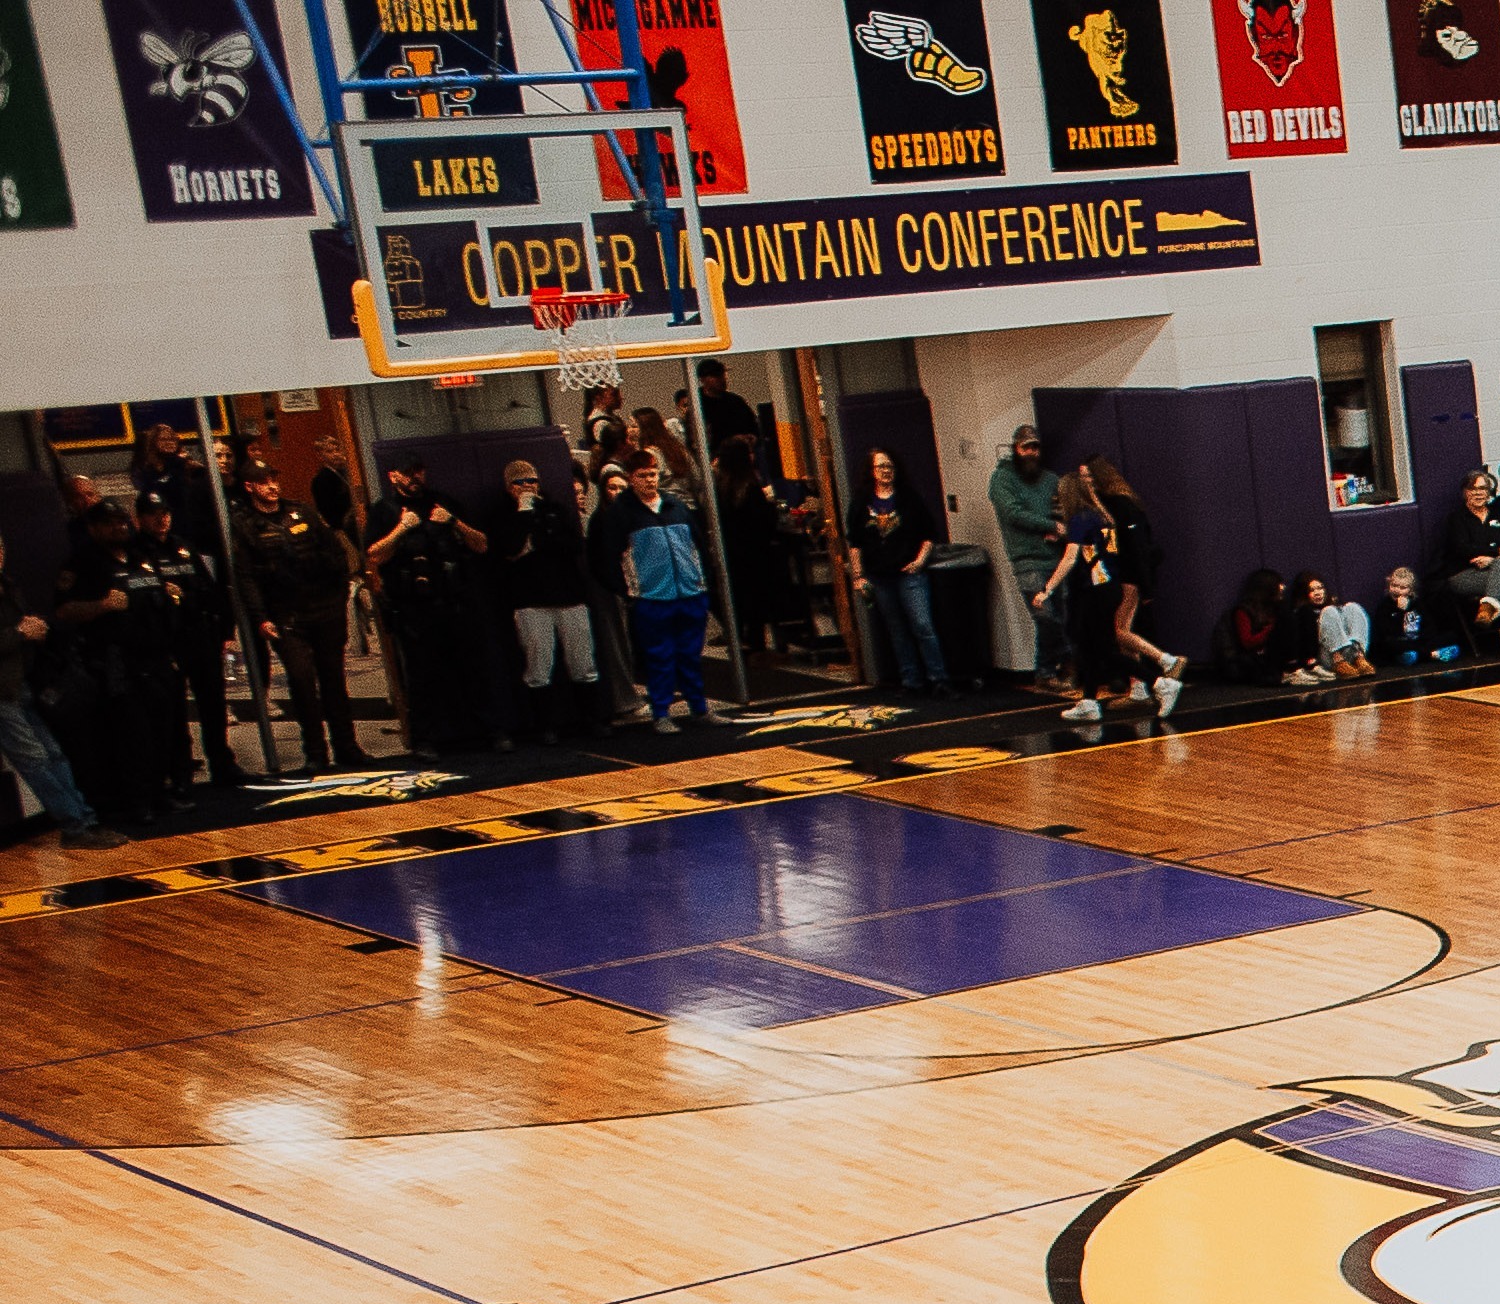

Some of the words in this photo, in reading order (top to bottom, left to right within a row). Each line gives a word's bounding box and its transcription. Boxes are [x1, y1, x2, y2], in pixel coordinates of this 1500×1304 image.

[577, 0, 718, 31] MICGAMME
[1067, 123, 1157, 151] PANTHERS
[1228, 110, 1267, 145] RED
[1272, 106, 1344, 141] DEVILS
[870, 129, 997, 170] SPEEDBOYS
[170, 164, 281, 204] HORNETS
[413, 156, 500, 197] LAKES
[896, 199, 1148, 274] CONFERENCE
